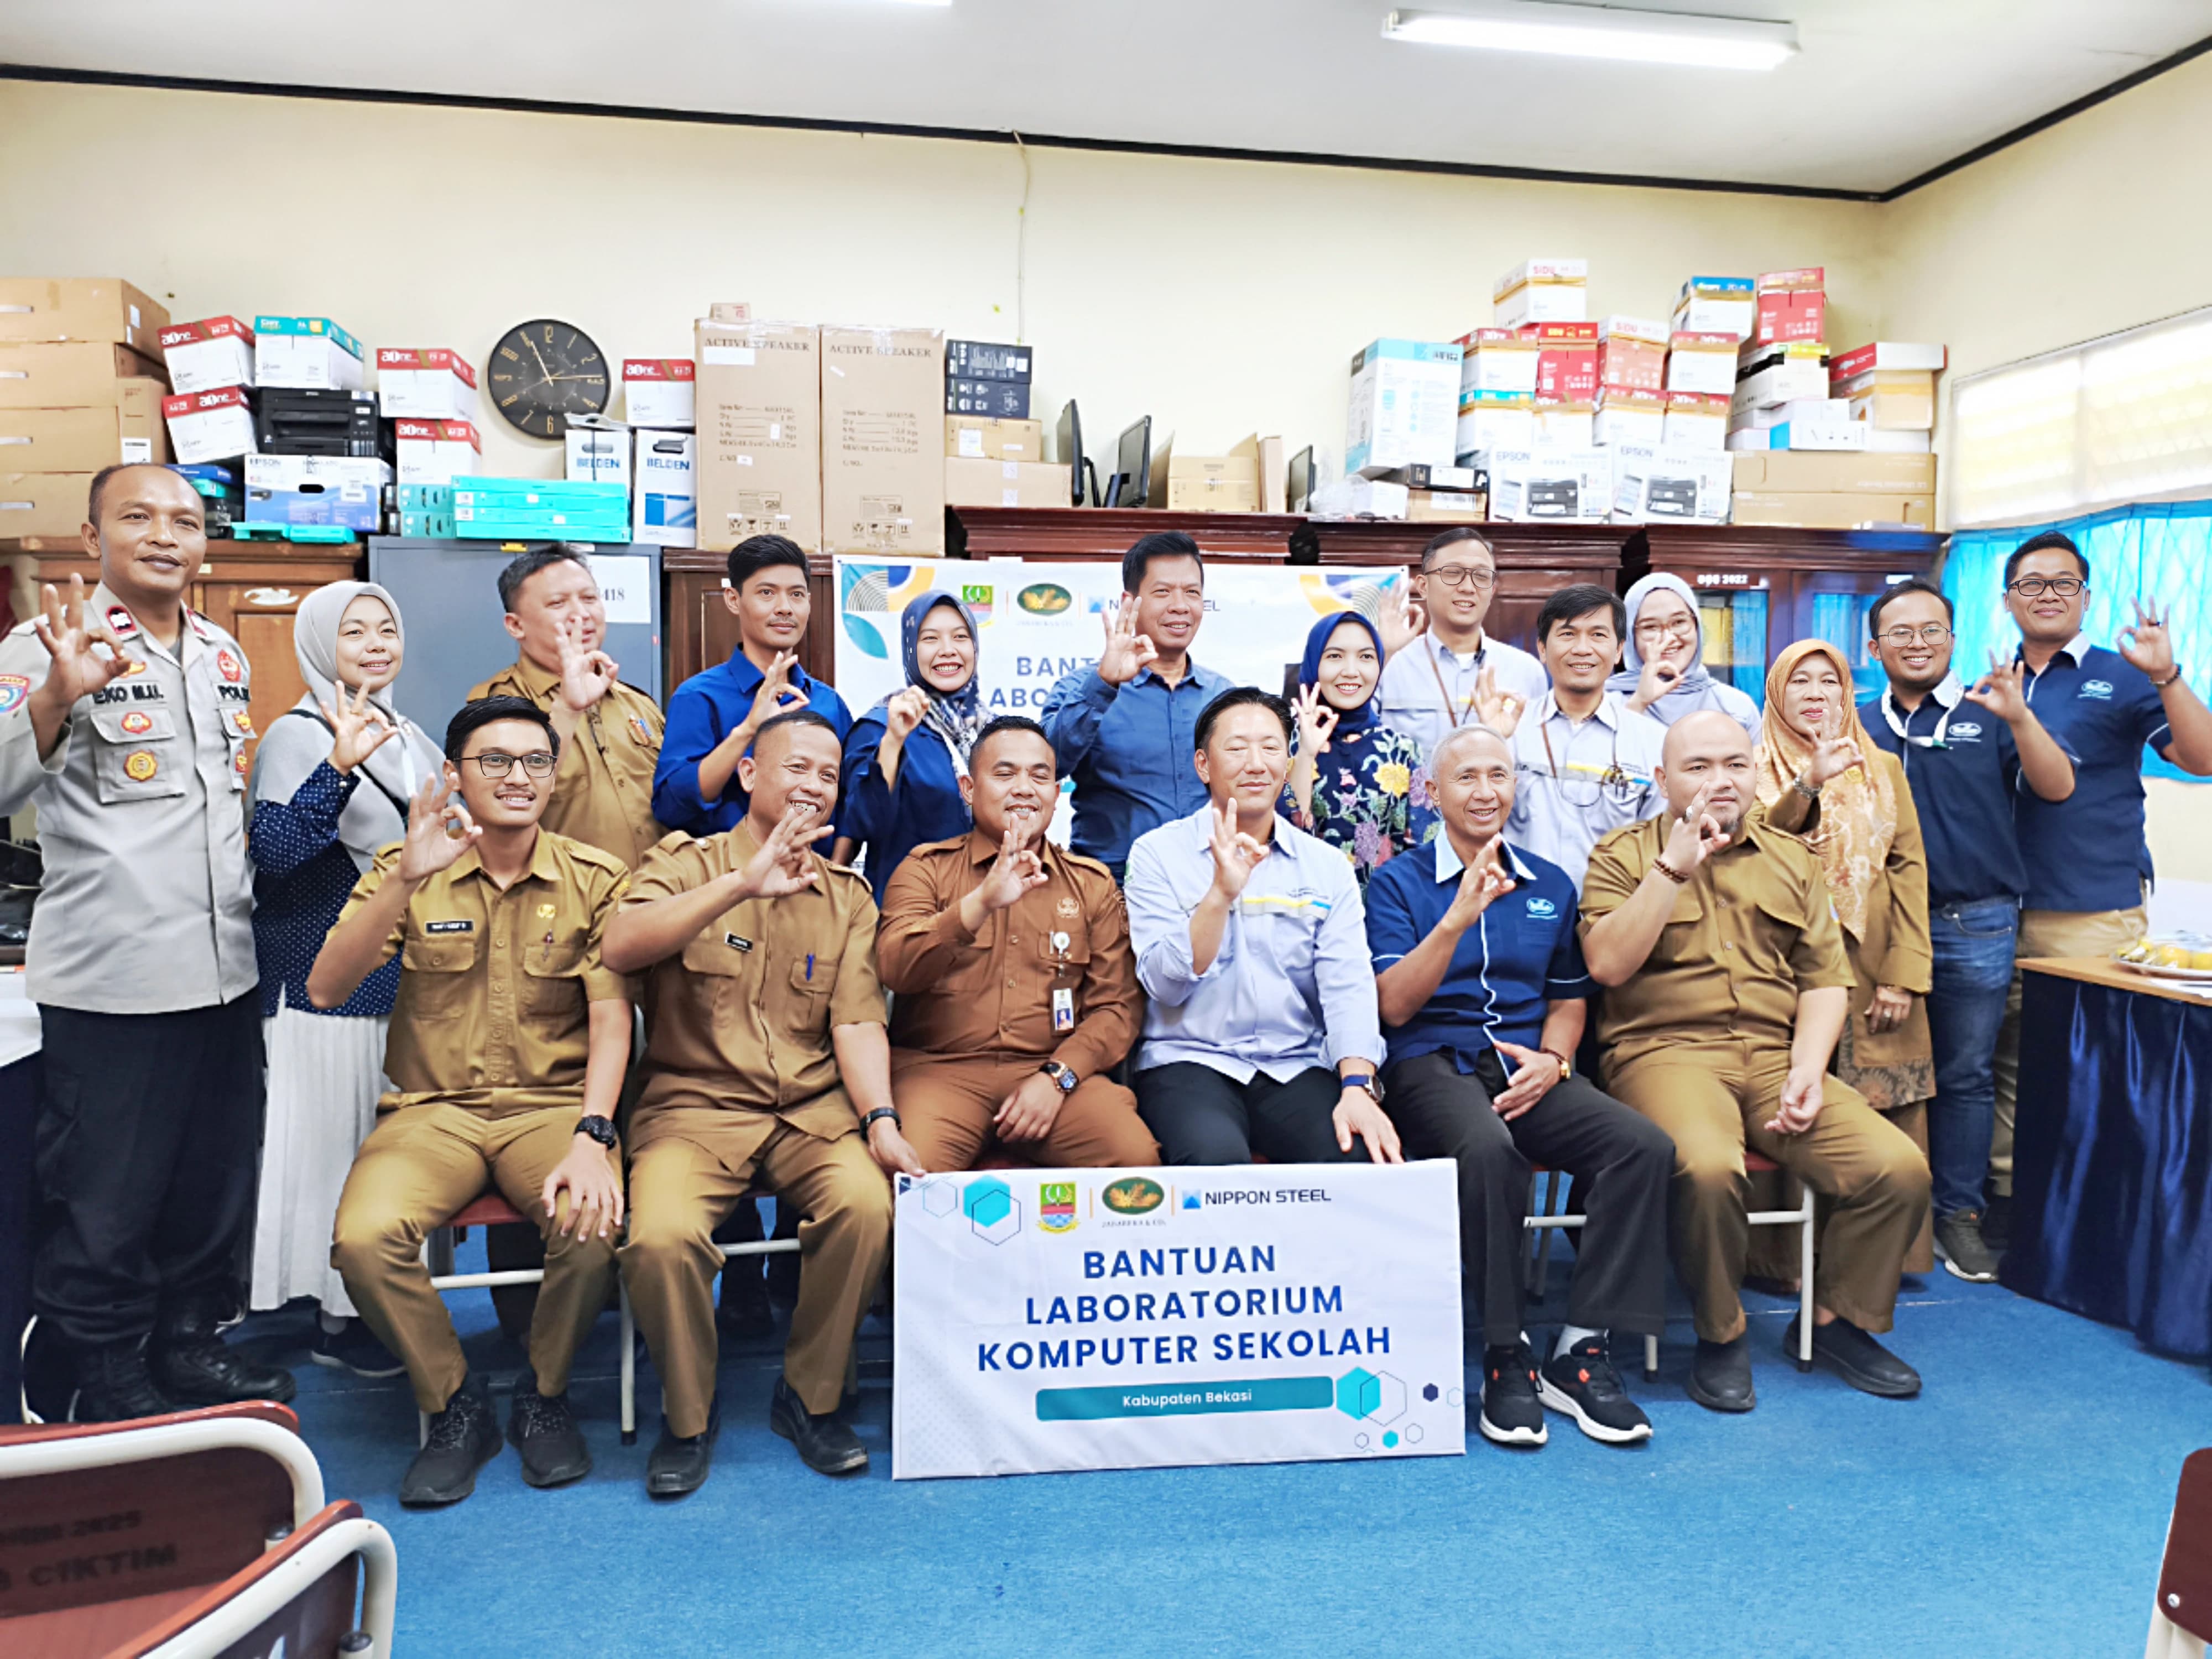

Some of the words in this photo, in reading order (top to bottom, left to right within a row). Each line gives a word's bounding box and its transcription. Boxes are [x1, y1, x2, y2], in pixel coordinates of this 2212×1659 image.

[705, 338, 749, 347] ACTIVE
[830, 345, 873, 354] ACTIVE
[877, 346, 932, 357] SPEAKER
[1496, 451, 1531, 461] EPSON
[1620, 445, 1654, 458] EPSON
[576, 457, 620, 468] BELDEN
[646, 457, 690, 470] BELDEN
[1206, 1190, 1270, 1205] NIPPON
[1276, 1188, 1332, 1203] STEEL
[1084, 1245, 1276, 1279] BANTUAN
[1026, 1285, 1344, 1325] LABORATORIUM
[978, 1334, 1198, 1371] KOMPUTER
[1213, 1327, 1390, 1362] SEKOLAH
[1123, 1392, 1201, 1408] Kabupaten
[1206, 1389, 1252, 1402] Bekasi
